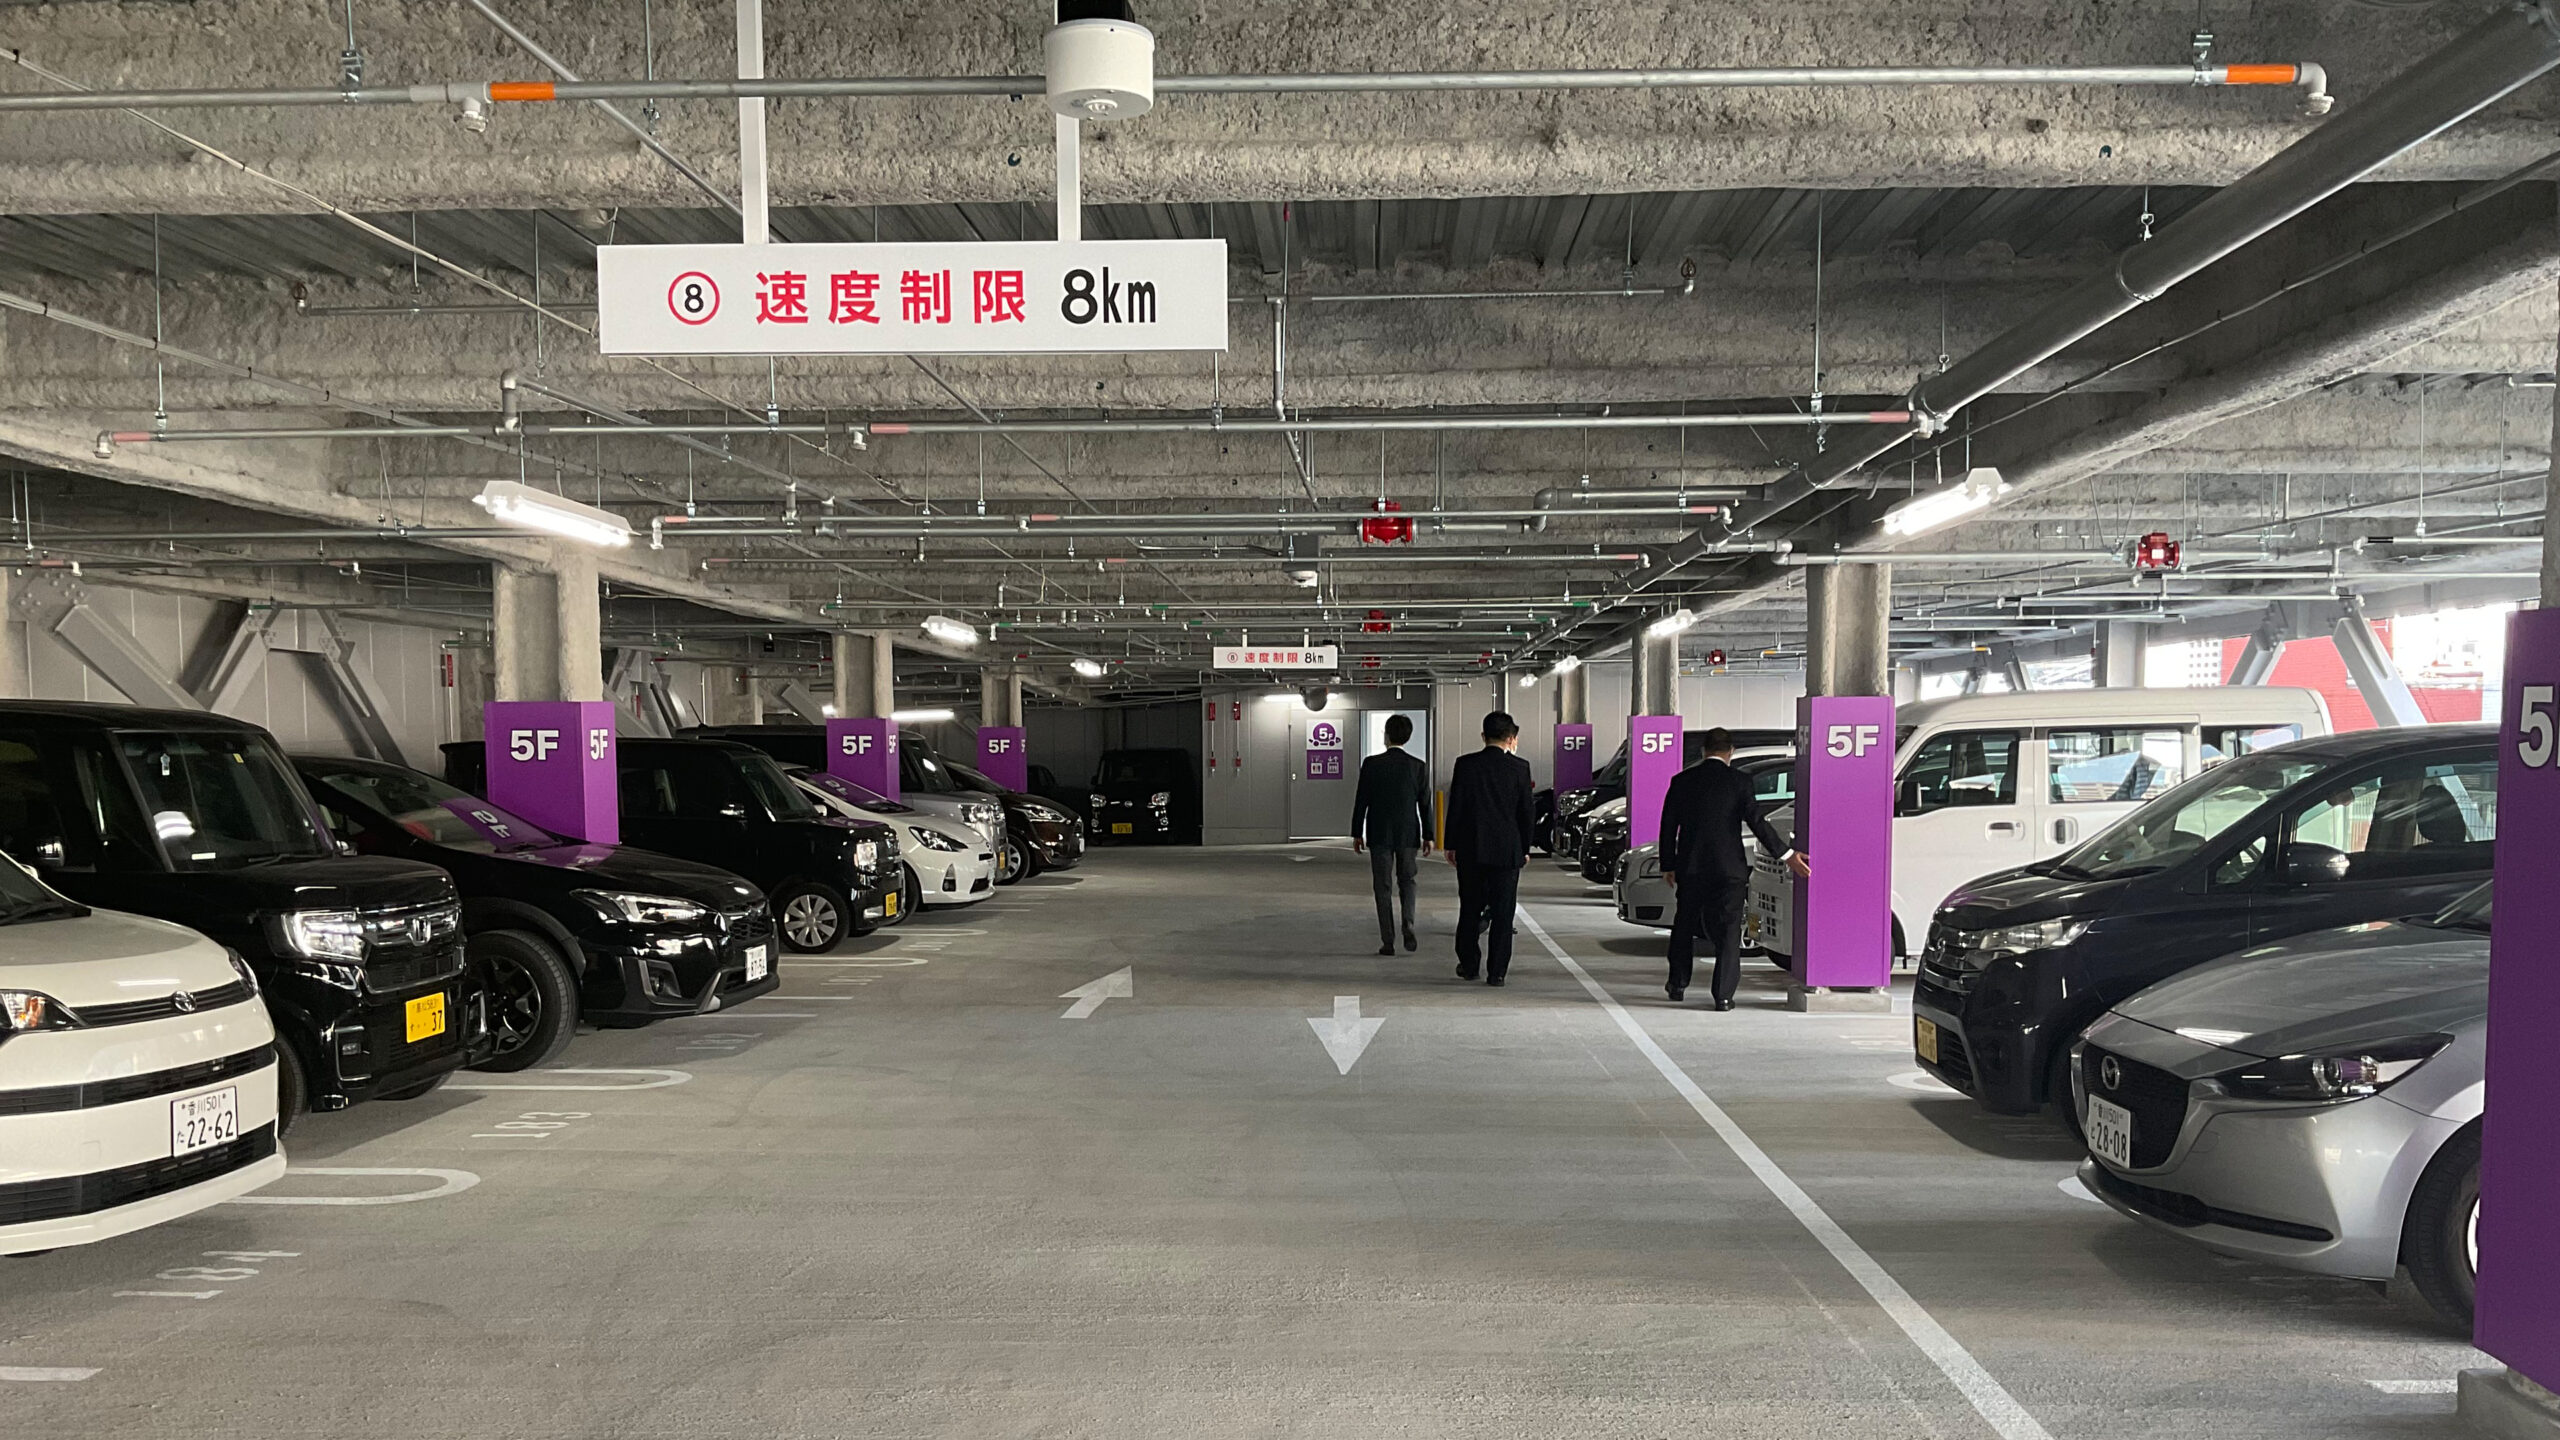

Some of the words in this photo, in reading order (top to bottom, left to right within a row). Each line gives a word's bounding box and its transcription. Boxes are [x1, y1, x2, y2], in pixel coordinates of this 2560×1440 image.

[755, 269, 1026, 325] 速度制限
[1061, 267, 1157, 324] 8km
[1244, 652, 1298, 664] 速度制限
[1304, 652, 1324, 664] 8km
[1319, 727, 1334, 740] 5F
[2518, 685, 2560, 768] 5
[510, 729, 560, 761] 5F
[590, 728, 609, 761] 5F
[842, 735, 873, 754] 5F
[988, 739, 1011, 754] 5F
[1563, 736, 1587, 751] 5F
[1642, 733, 1674, 753] 5F
[1827, 725, 1880, 758] 5F
[471, 1111, 592, 1139] 183
